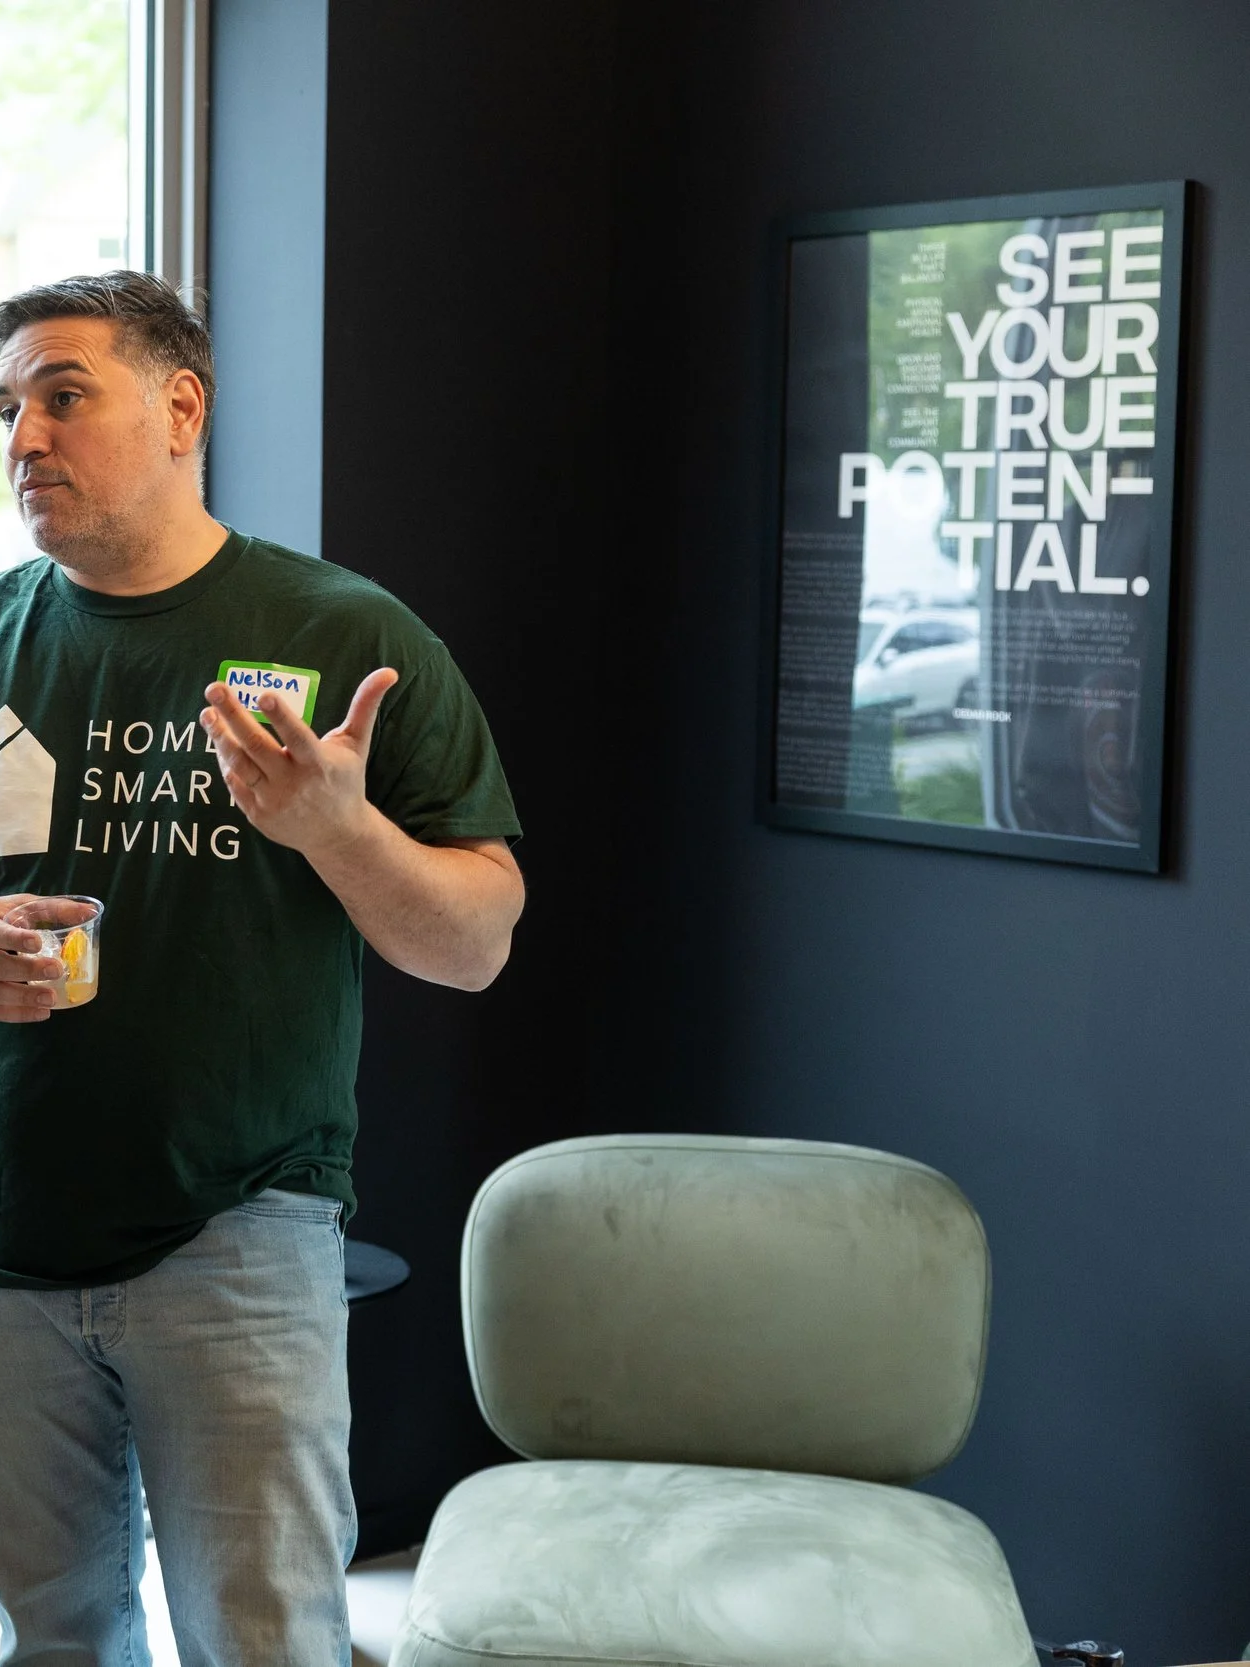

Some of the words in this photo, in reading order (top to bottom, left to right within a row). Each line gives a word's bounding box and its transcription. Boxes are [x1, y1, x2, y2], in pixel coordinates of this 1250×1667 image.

[997, 225, 1163, 307] SEE
[947, 302, 1160, 379] YOUR
[944, 376, 1158, 450] TRUE
[838, 450, 1153, 521] POTEN-
[941, 522, 1150, 597] TIAL.
[229, 670, 299, 692] Nelson
[81, 767, 237, 807] SMAR
[75, 818, 240, 861] LIVING
